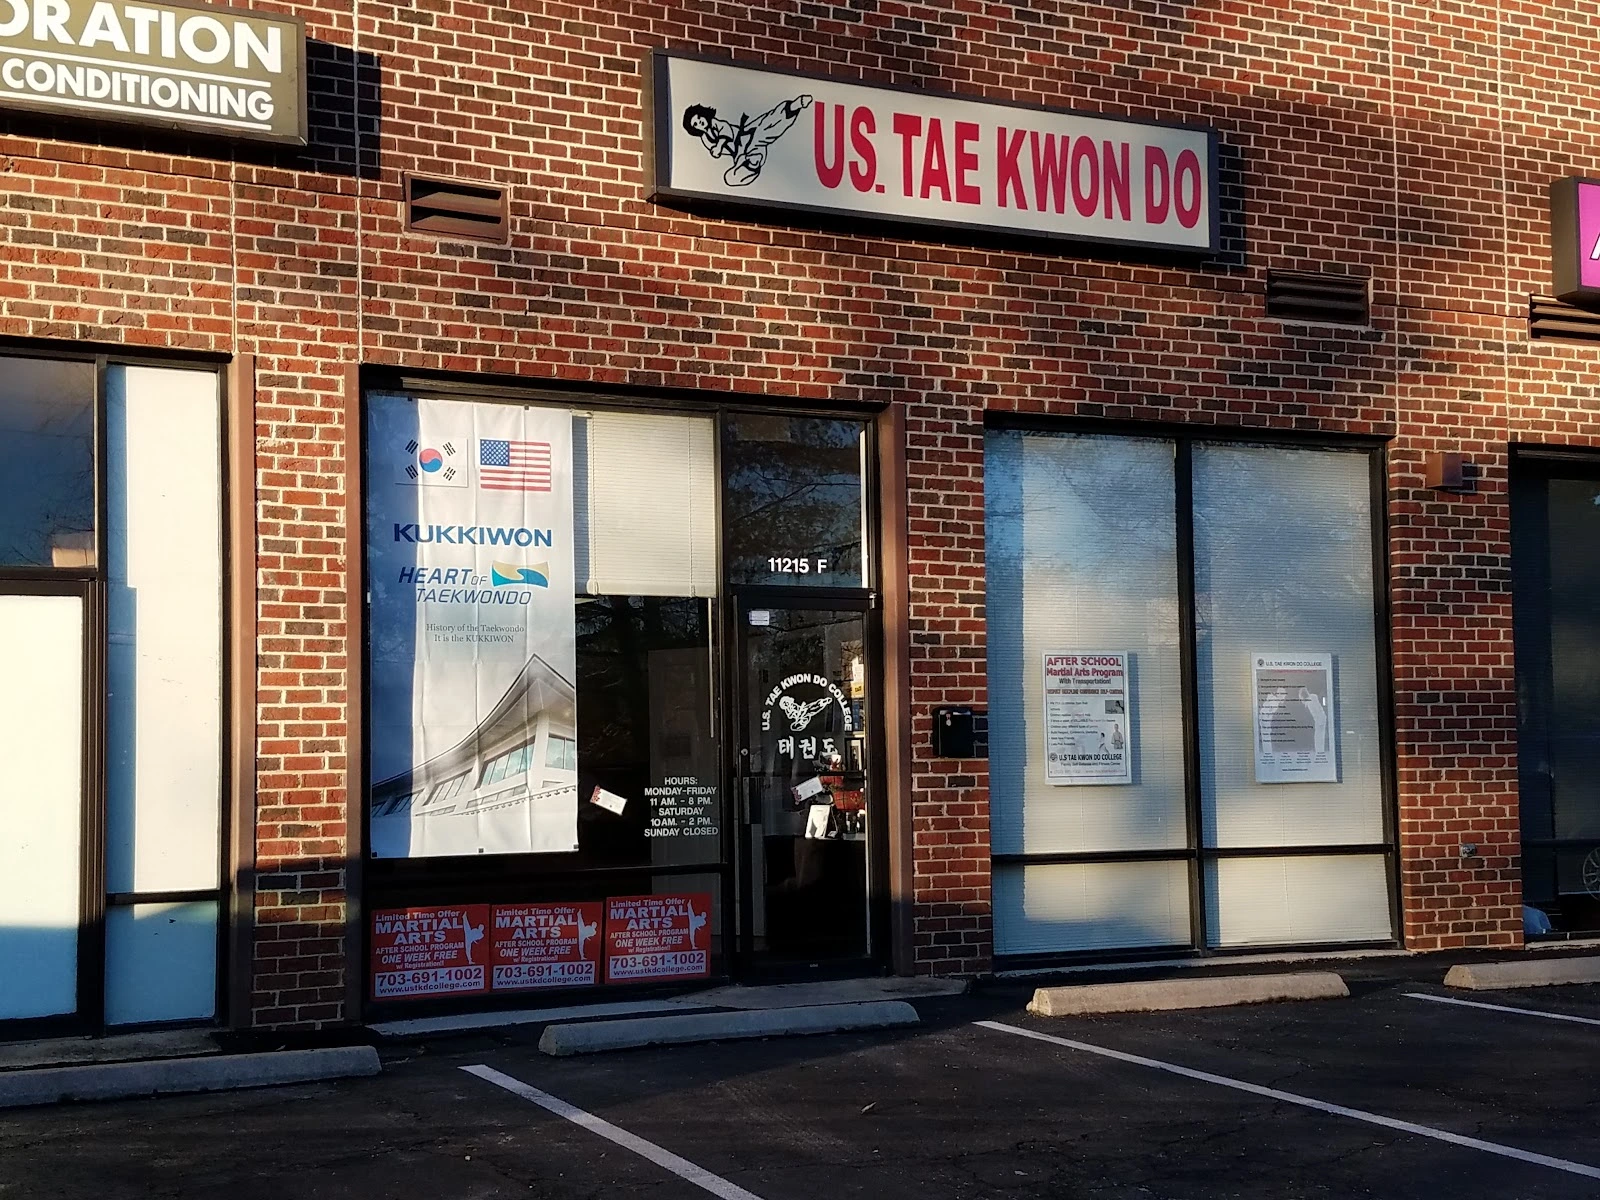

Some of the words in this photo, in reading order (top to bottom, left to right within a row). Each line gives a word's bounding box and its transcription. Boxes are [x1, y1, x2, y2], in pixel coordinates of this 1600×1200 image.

[0, 0, 282, 73] ORATION
[2, 58, 275, 121] CONDITIONING
[893, 112, 980, 205] TAE
[997, 126, 1132, 222] KWON
[1144, 146, 1201, 229] DO
[393, 523, 552, 547] KUKKIWON
[768, 557, 809, 573] 11215
[818, 559, 828, 573] F
[398, 566, 472, 585] HEART
[471, 575, 488, 586] OF
[416, 588, 532, 605] TAEKWONDO
[426, 624, 456, 633] History
[457, 624, 466, 632] of
[467, 624, 479, 632] the
[480, 624, 525, 633] Taekwondo
[434, 634, 441, 642] It
[443, 634, 450, 642] is
[451, 634, 464, 642] the
[465, 635, 514, 643] KUKKIWON
[1047, 657, 1079, 666] AFTER
[1081, 657, 1122, 667] SCHOOL
[1047, 667, 1073, 676] Martial
[1074, 668, 1090, 676] Arts
[1092, 668, 1124, 678] Program
[780, 673, 811, 690] KWON
[813, 674, 828, 687] DO
[765, 685, 783, 707] TAE
[828, 683, 853, 732] COLLEGE
[762, 709, 772, 731] U.S.
[1094, 753, 1101, 761] DO
[1101, 753, 1122, 761] COLLEGE
[664, 776, 698, 785] HOURS:
[644, 786, 717, 796] MONDAY-FRIDAY
[650, 798, 657, 806] 11
[660, 797, 677, 806] AM.
[688, 797, 694, 806] 8
[697, 797, 713, 805] PM.
[658, 807, 704, 816] SATURDAY
[650, 818, 660, 827] 10
[660, 818, 678, 826] AM.
[688, 817, 694, 826] 2
[697, 817, 713, 825] PM.
[644, 828, 680, 837] SUNDAY
[683, 827, 719, 836] CLOSED
[610, 900, 641, 908] Limited
[665, 897, 685, 905] Offer
[376, 912, 410, 922] Limited
[412, 911, 435, 920] Time
[437, 909, 460, 917] Offer
[496, 908, 529, 916] Limited
[610, 904, 688, 920] MARTIAL
[375, 917, 463, 934] MARTIAL
[495, 914, 578, 928] MARTIAL
[626, 917, 673, 930] ARTS
[394, 930, 446, 945] ARTS
[512, 926, 561, 939] ARTS
[610, 931, 631, 939] AFTER
[658, 928, 689, 936] PROGRAM
[376, 946, 399, 954] AFTER
[400, 944, 429, 952] SCHOOL
[430, 941, 465, 950] PROGRAM
[495, 940, 516, 948] AFTER
[517, 939, 544, 947] SCHOOL
[615, 938, 634, 948] ONE
[635, 937, 660, 947] WEEK
[661, 935, 683, 945] FREE
[381, 953, 401, 964] ONE
[404, 951, 431, 962] WEEK
[433, 950, 458, 960] FREE
[500, 948, 519, 957] ONE
[521, 946, 547, 956] WEEK
[549, 946, 571, 955] FREE
[611, 952, 705, 969] 703-691-1002
[495, 963, 593, 979] 703-691-1002
[613, 964, 703, 976] www.ustkdcollege.com
[377, 968, 482, 986] 703-691-1002
[496, 975, 591, 986] www.ustkdcollege.com
[379, 980, 480, 994] www.ustkdcollege.com
